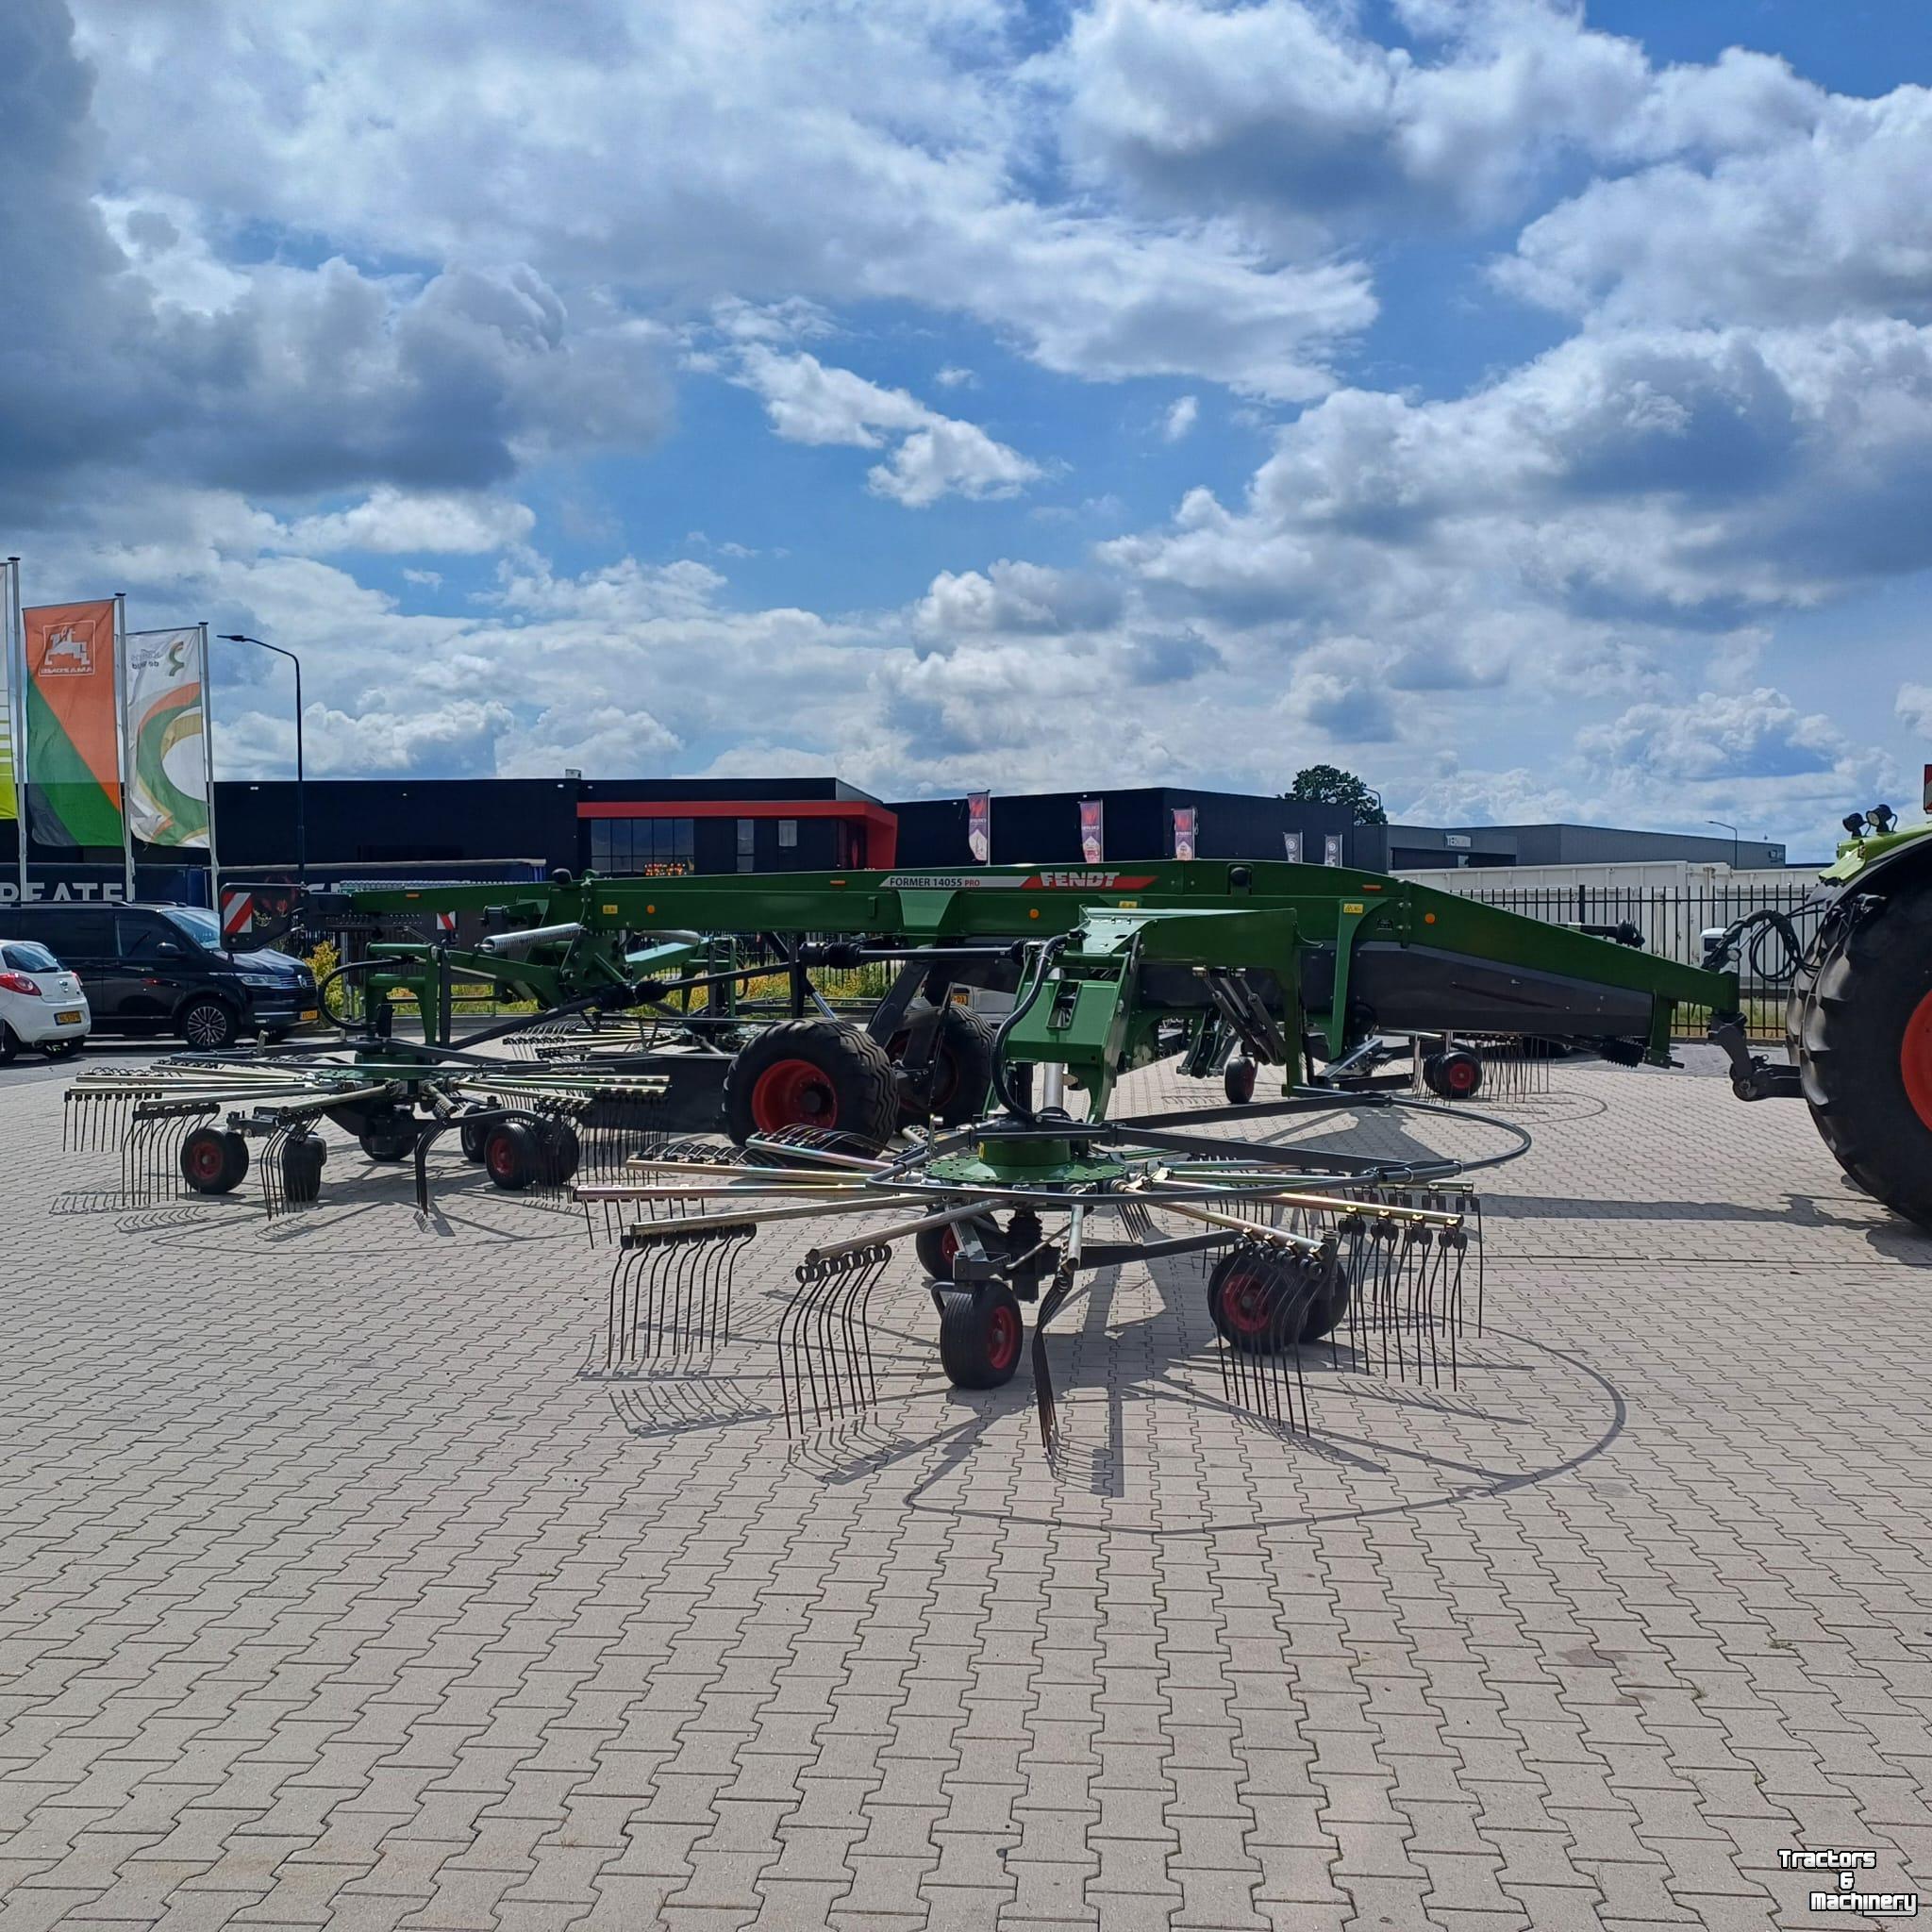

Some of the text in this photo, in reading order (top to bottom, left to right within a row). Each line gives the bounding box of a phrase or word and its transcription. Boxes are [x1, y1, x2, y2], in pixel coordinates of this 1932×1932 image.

[890, 877, 930, 887] FORMER
[933, 877, 962, 887] 14055
[1040, 872, 1120, 887] FENDT
